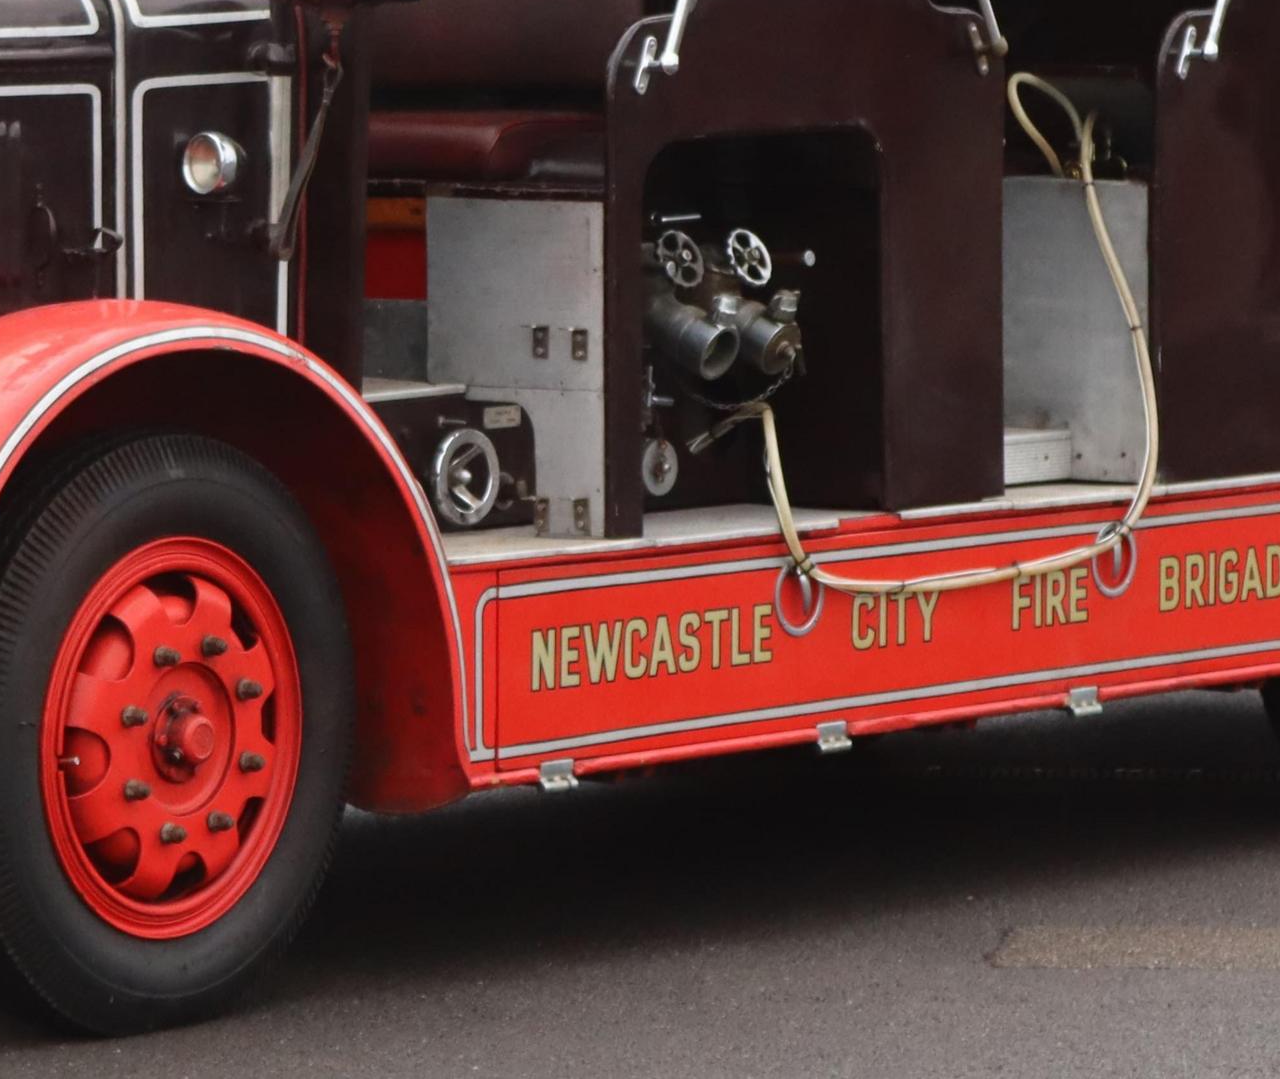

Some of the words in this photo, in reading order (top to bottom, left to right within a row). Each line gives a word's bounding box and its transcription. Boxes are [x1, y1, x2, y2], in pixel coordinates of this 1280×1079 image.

[530, 604, 773, 692] NEWCASTLE
[851, 590, 941, 651] CITY
[1011, 568, 1089, 631] FIRE
